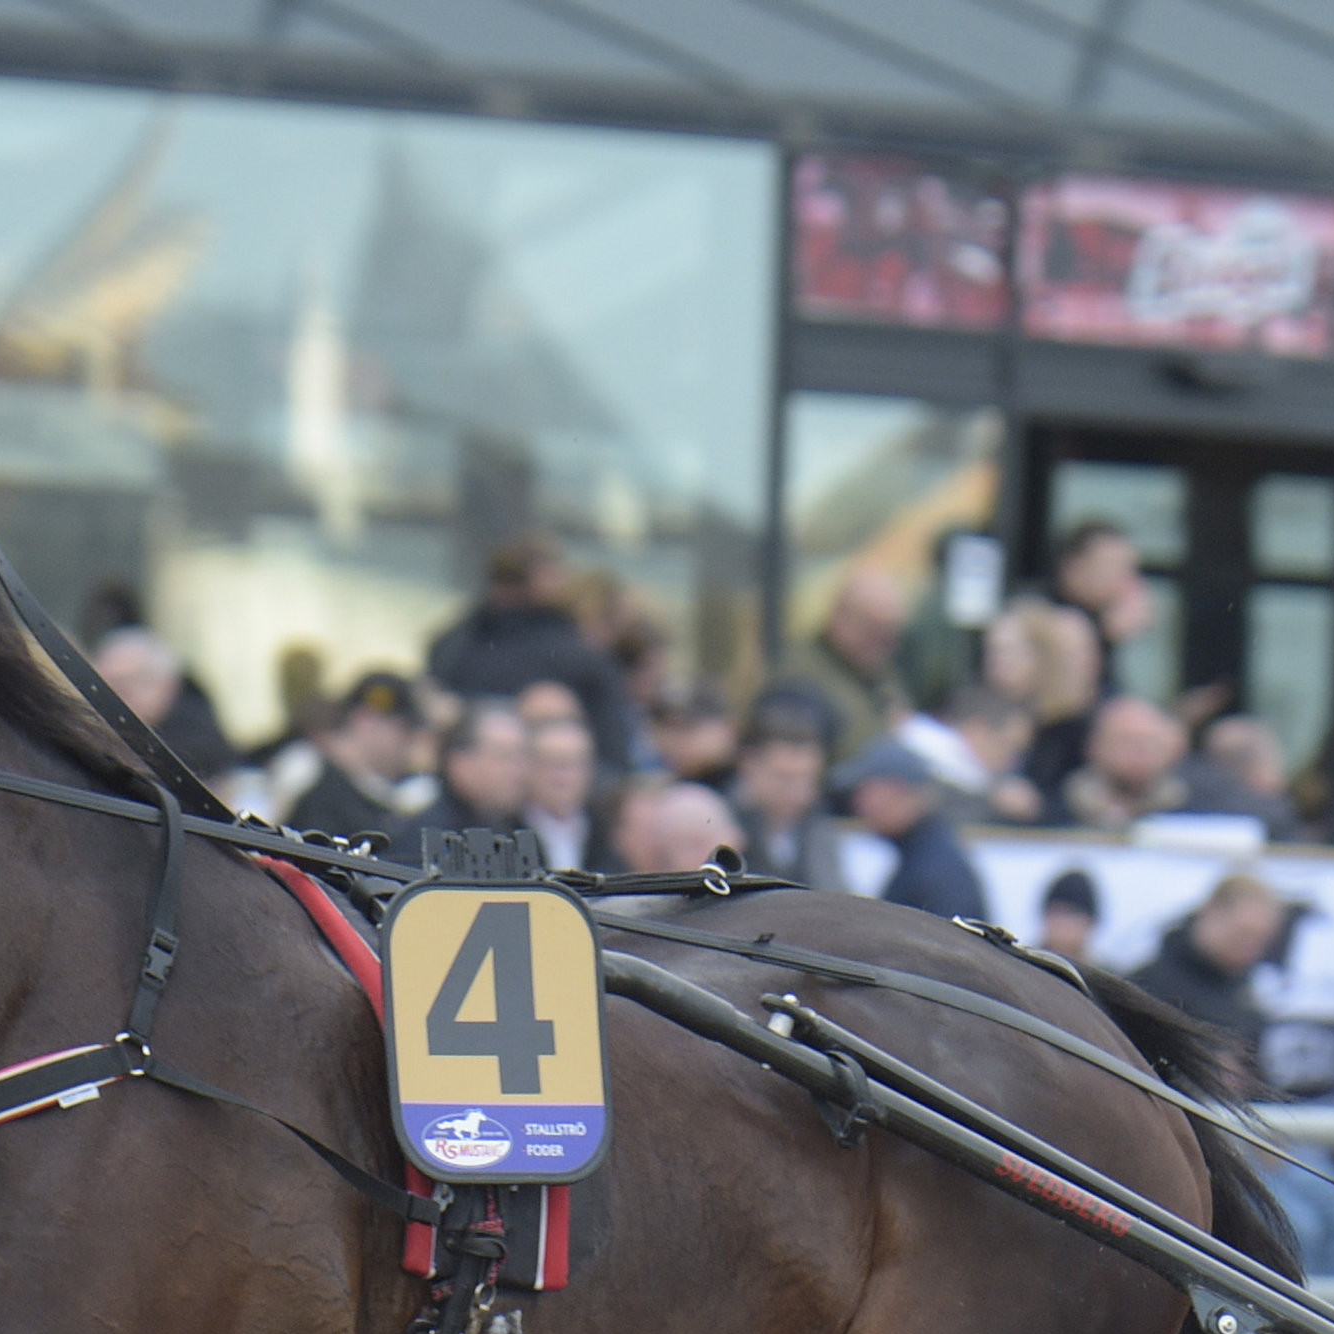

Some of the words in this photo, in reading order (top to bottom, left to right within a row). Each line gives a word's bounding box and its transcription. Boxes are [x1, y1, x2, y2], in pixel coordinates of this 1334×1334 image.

[426, 901, 556, 1095] 4
[524, 1122, 587, 1136] STALLSTRÖ
[525, 1144, 565, 1157] FODER
[994, 1151, 1132, 1238] SVEDBERG
